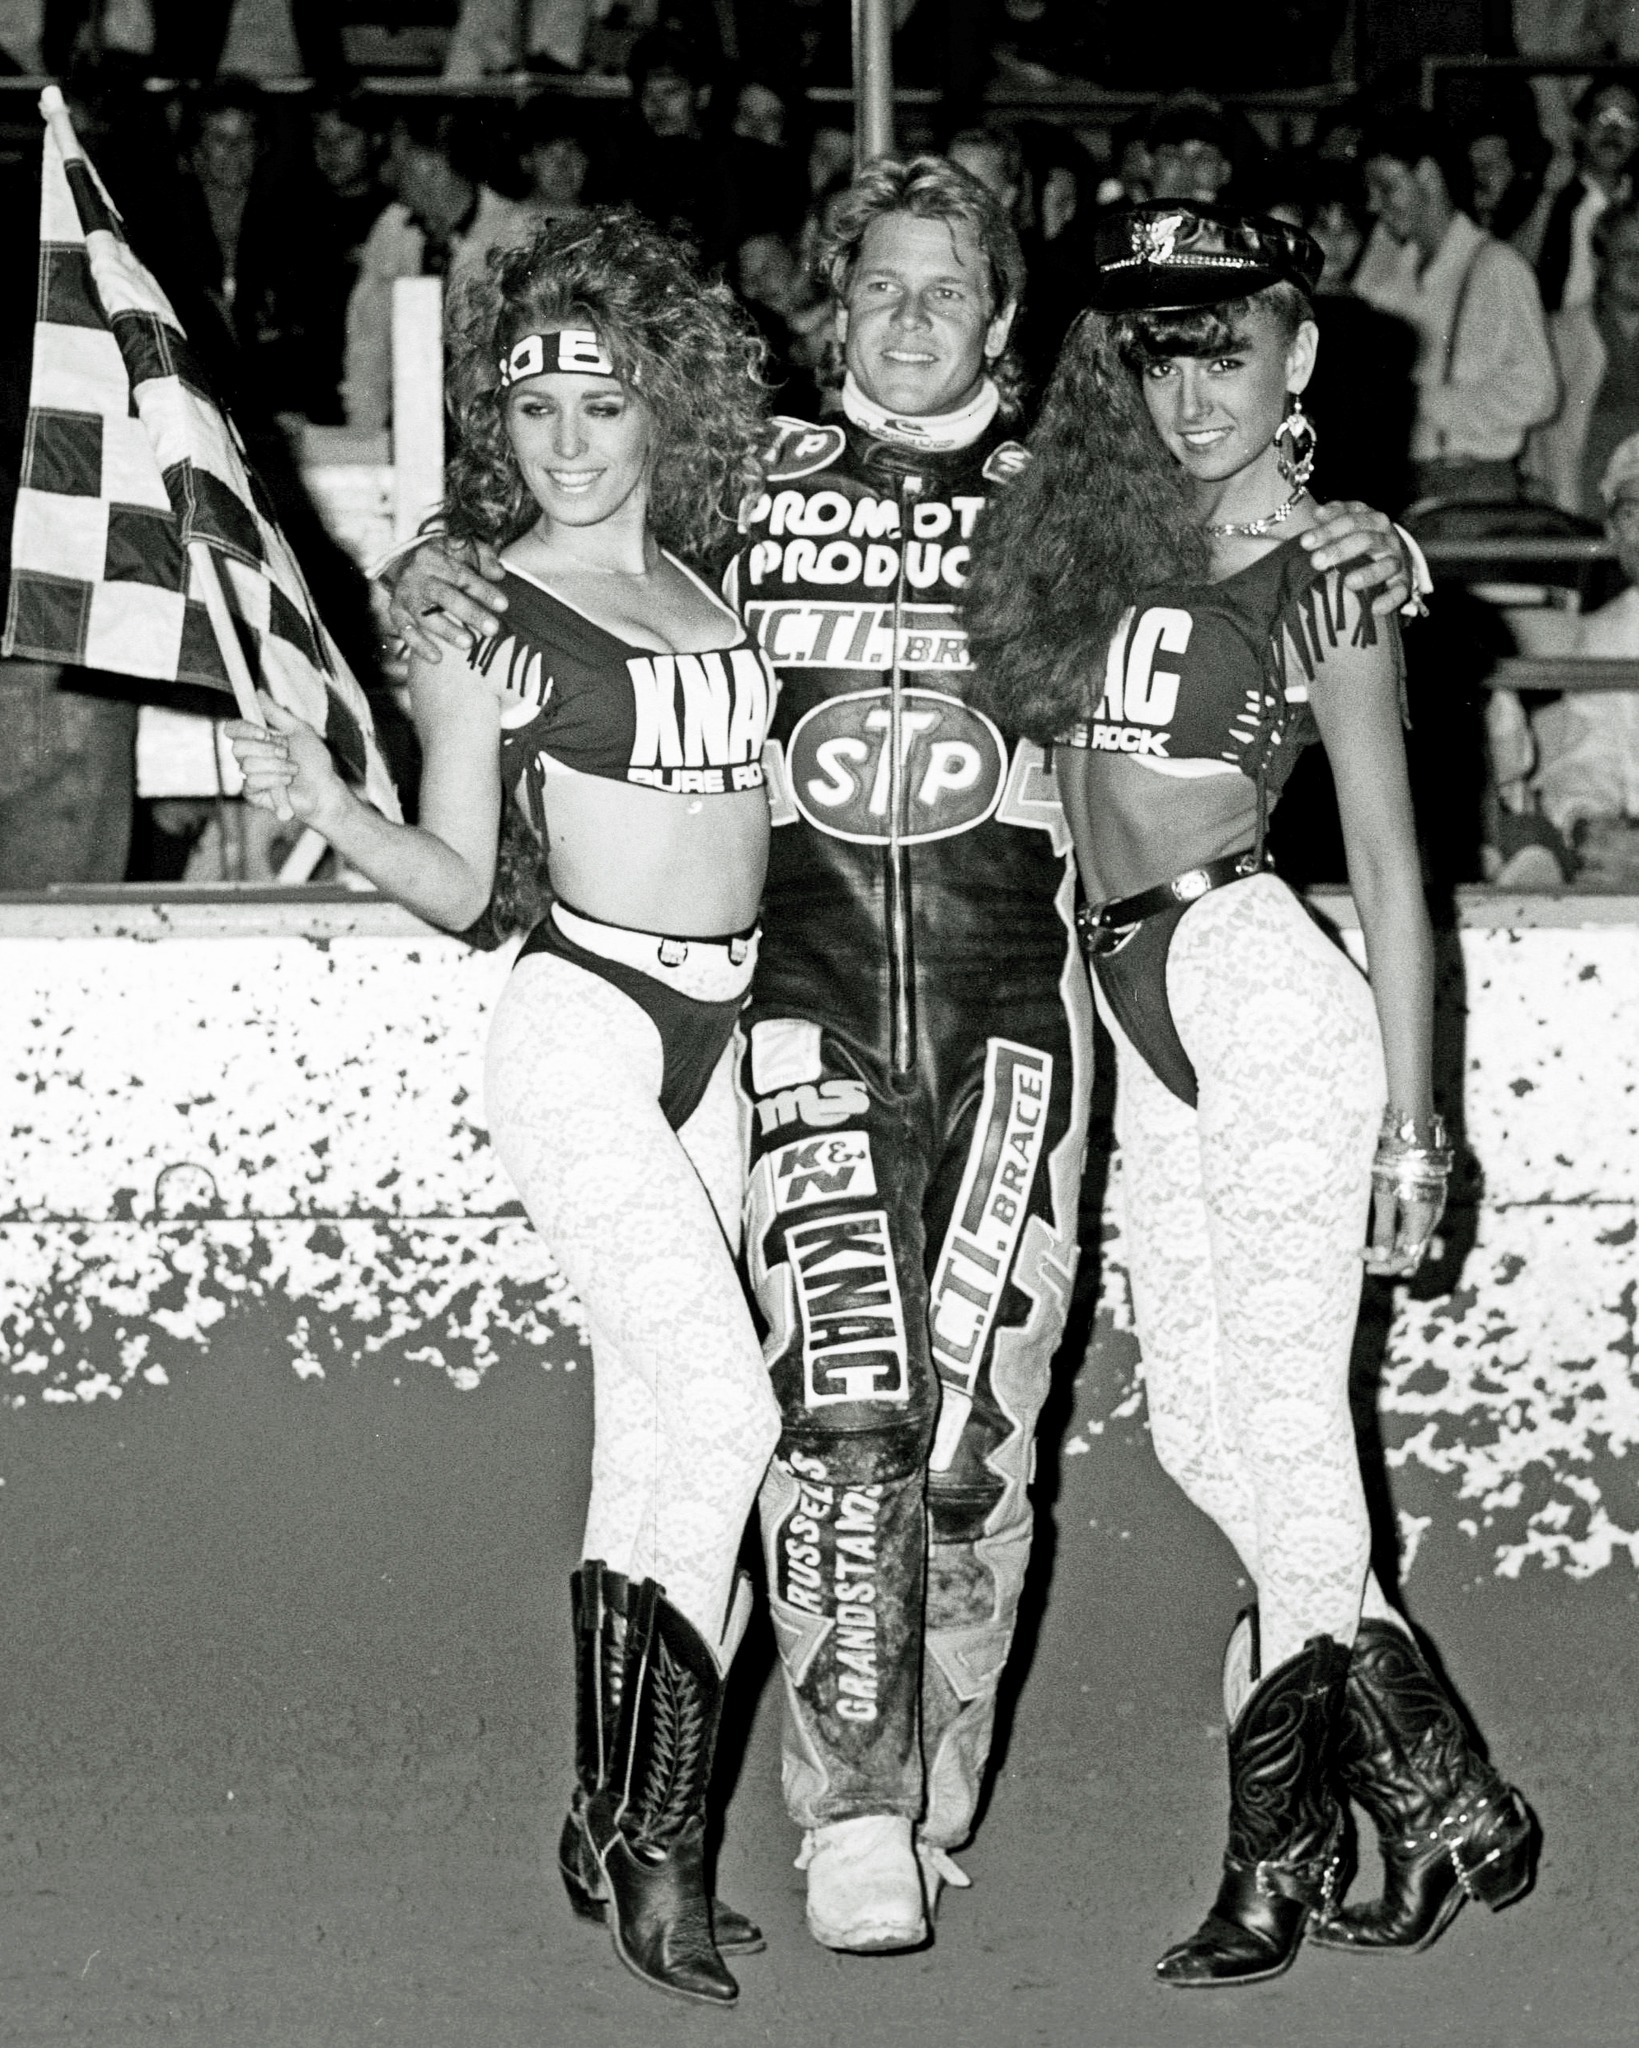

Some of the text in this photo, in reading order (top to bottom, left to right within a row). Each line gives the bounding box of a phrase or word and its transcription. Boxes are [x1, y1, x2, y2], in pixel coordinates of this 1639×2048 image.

[763, 424, 829, 463] TP
[902, 634, 970, 663] BR
[1093, 604, 1194, 726] AC
[625, 649, 776, 767] KNA
[807, 708, 982, 817] STP
[1091, 723, 1172, 758] ROCK
[730, 761, 764, 791] RO
[990, 1071, 1043, 1227] BRACE
[792, 1217, 902, 1396] KNAC
